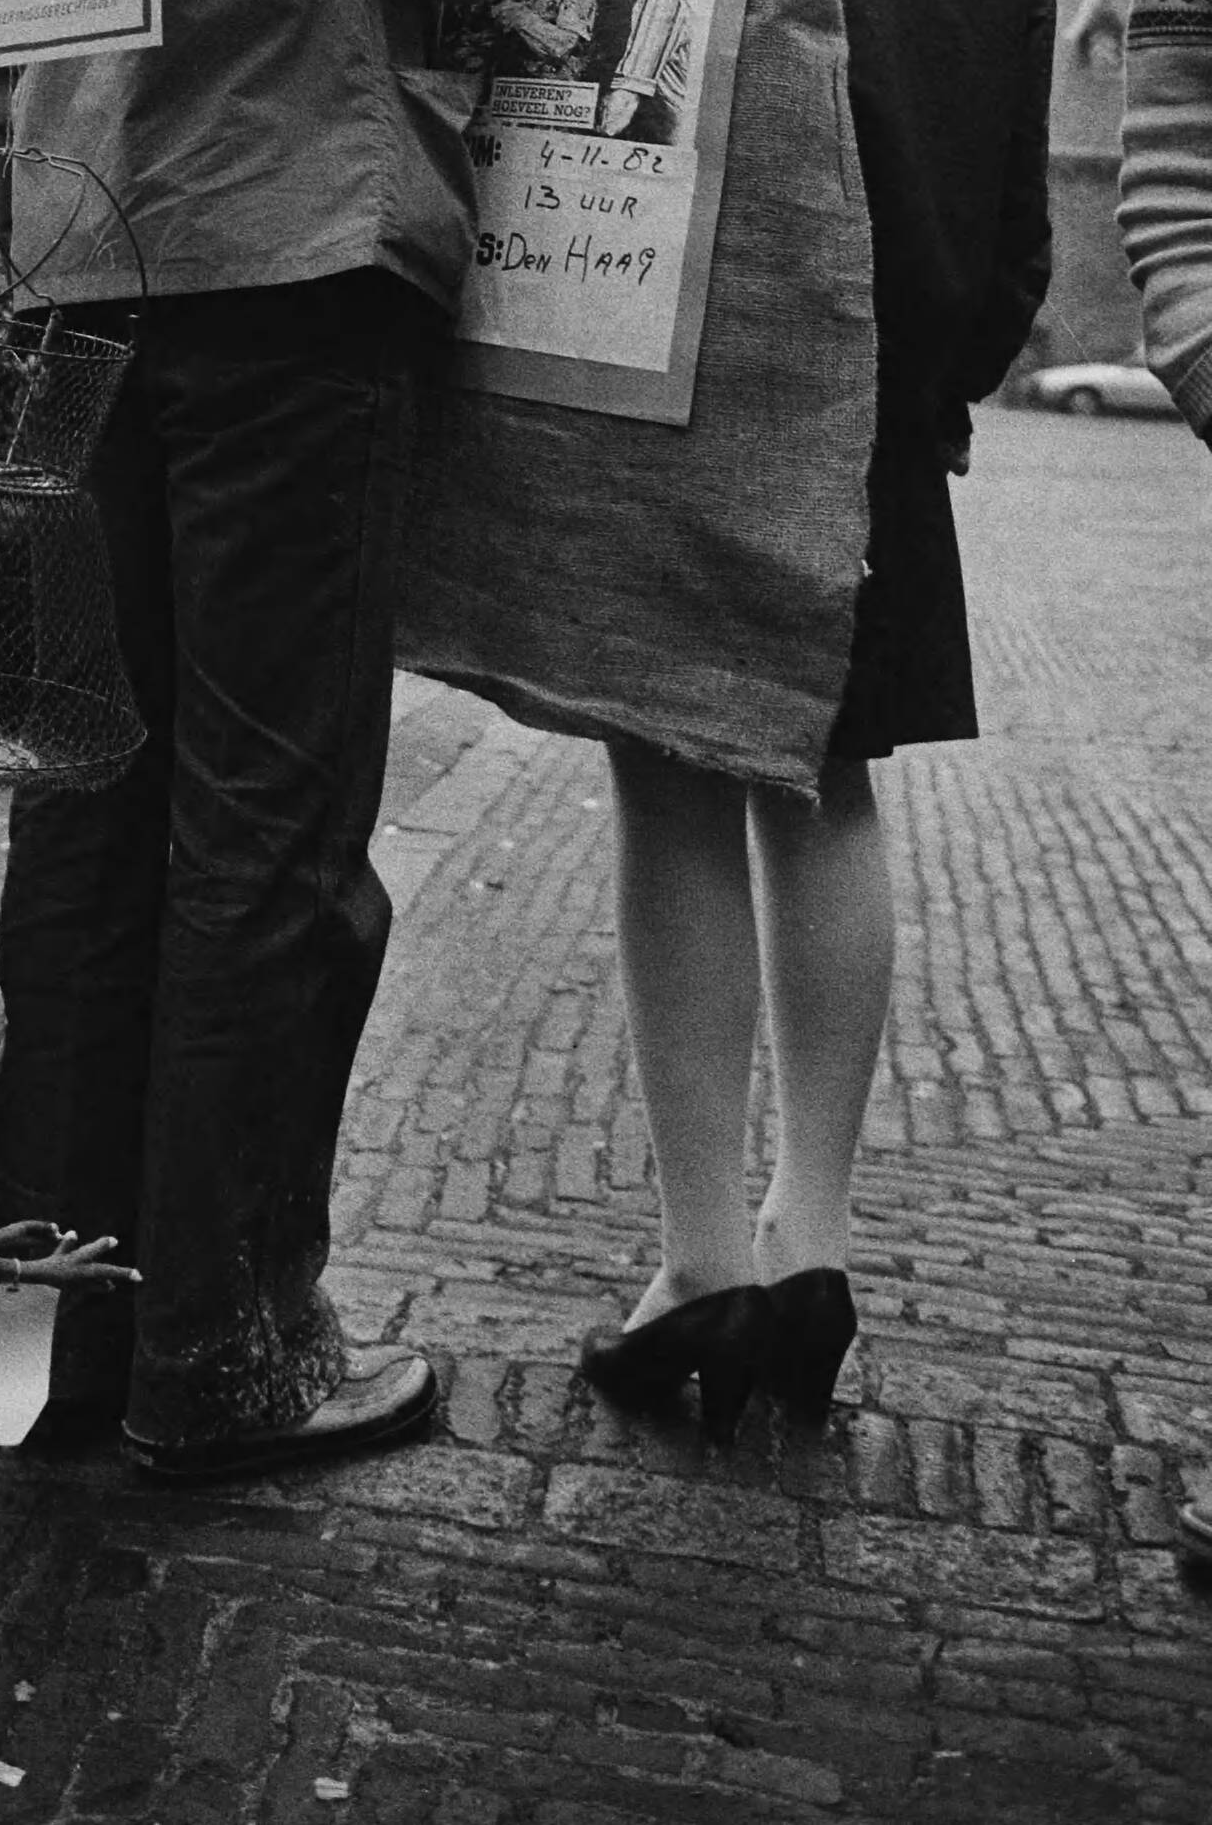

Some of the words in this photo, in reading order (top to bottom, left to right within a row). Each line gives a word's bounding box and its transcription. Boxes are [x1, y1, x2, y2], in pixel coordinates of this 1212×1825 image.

[494, 85, 573, 102] INLEVEREN?
[492, 100, 549, 116] HOEVEEL
[554, 105, 591, 119] NOG?
[524, 185, 561, 210] 13
